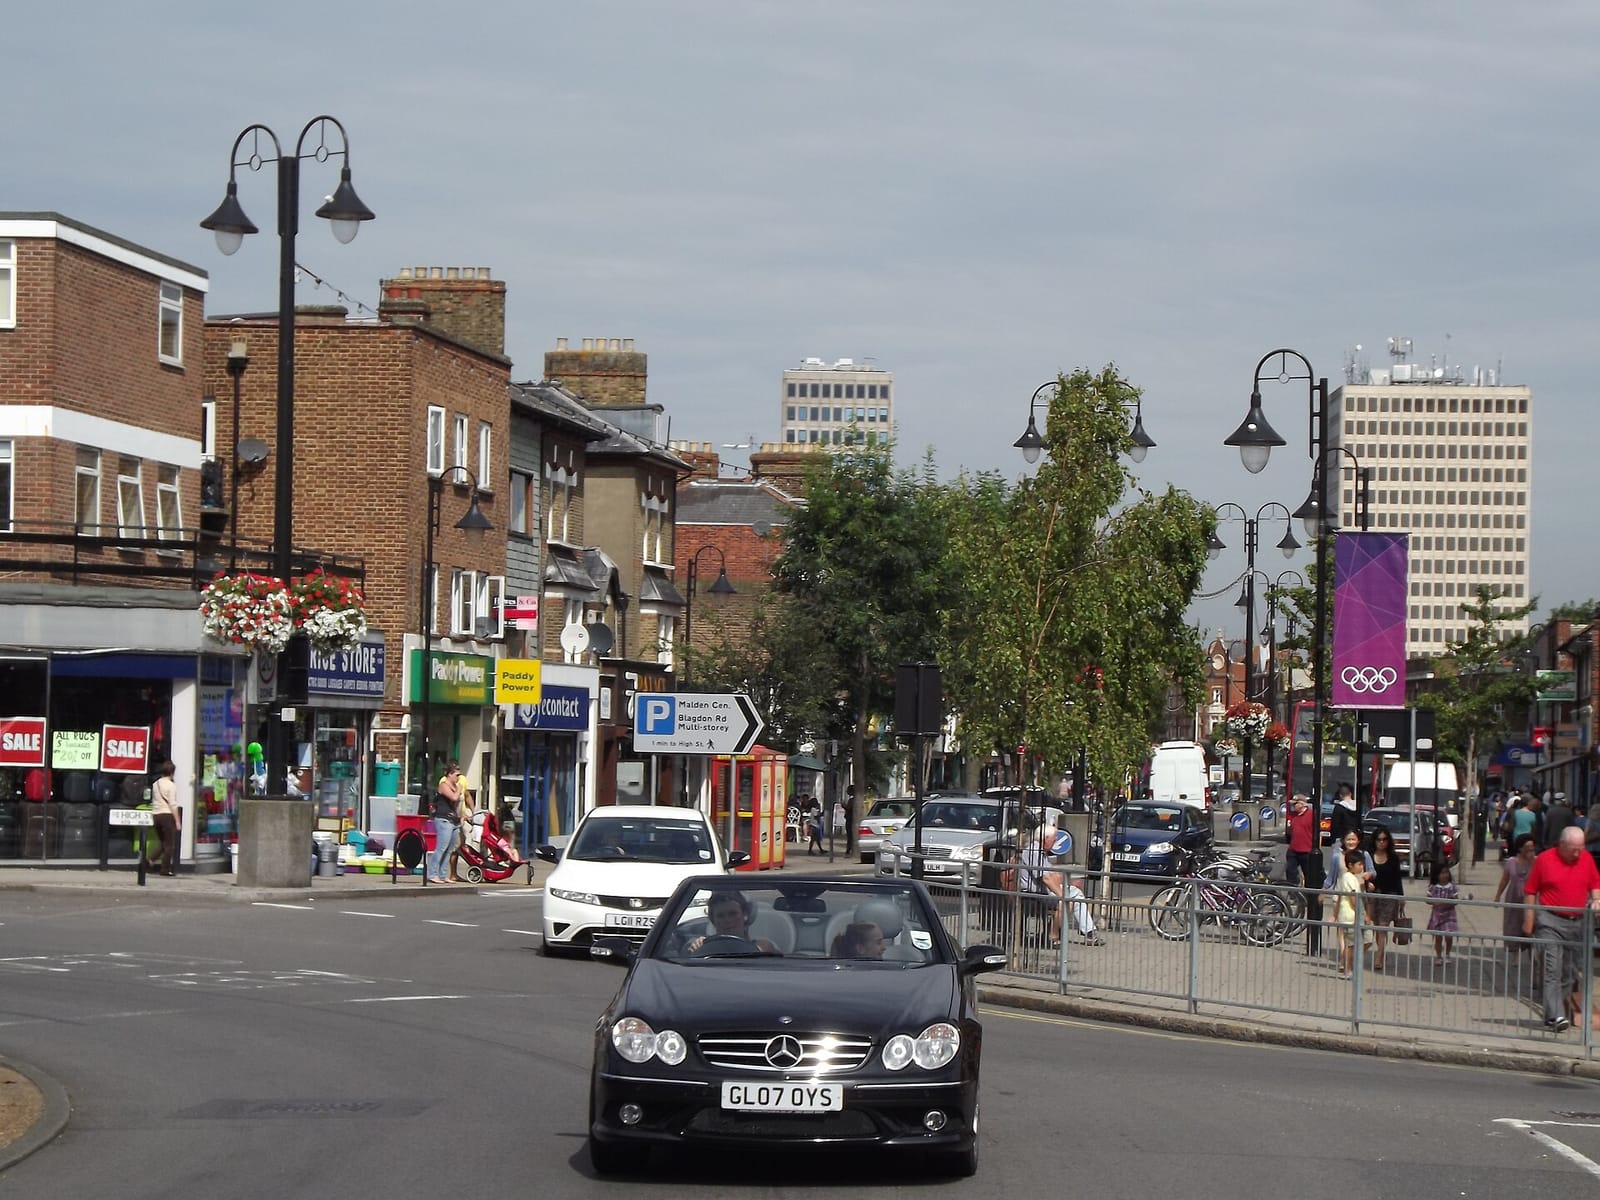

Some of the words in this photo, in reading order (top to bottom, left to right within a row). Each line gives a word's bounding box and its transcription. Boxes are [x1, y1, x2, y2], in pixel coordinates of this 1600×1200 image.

[341, 646, 376, 674] STORE
[432, 657, 457, 686] Paddy
[458, 660, 485, 683] Power
[502, 671, 535, 681] Paddy
[502, 683, 535, 692] Power
[678, 701, 710, 709] Malden
[711, 701, 731, 709] Cen.
[646, 700, 670, 732] P
[678, 714, 713, 723] Blagdon
[678, 723, 729, 732] Multi-storey
[2, 732, 41, 751] SALE
[107, 739, 144, 758] SALE
[121, 811, 141, 819] HIGH
[729, 1086, 784, 1106] GL07
[791, 1088, 832, 1107] OYS
